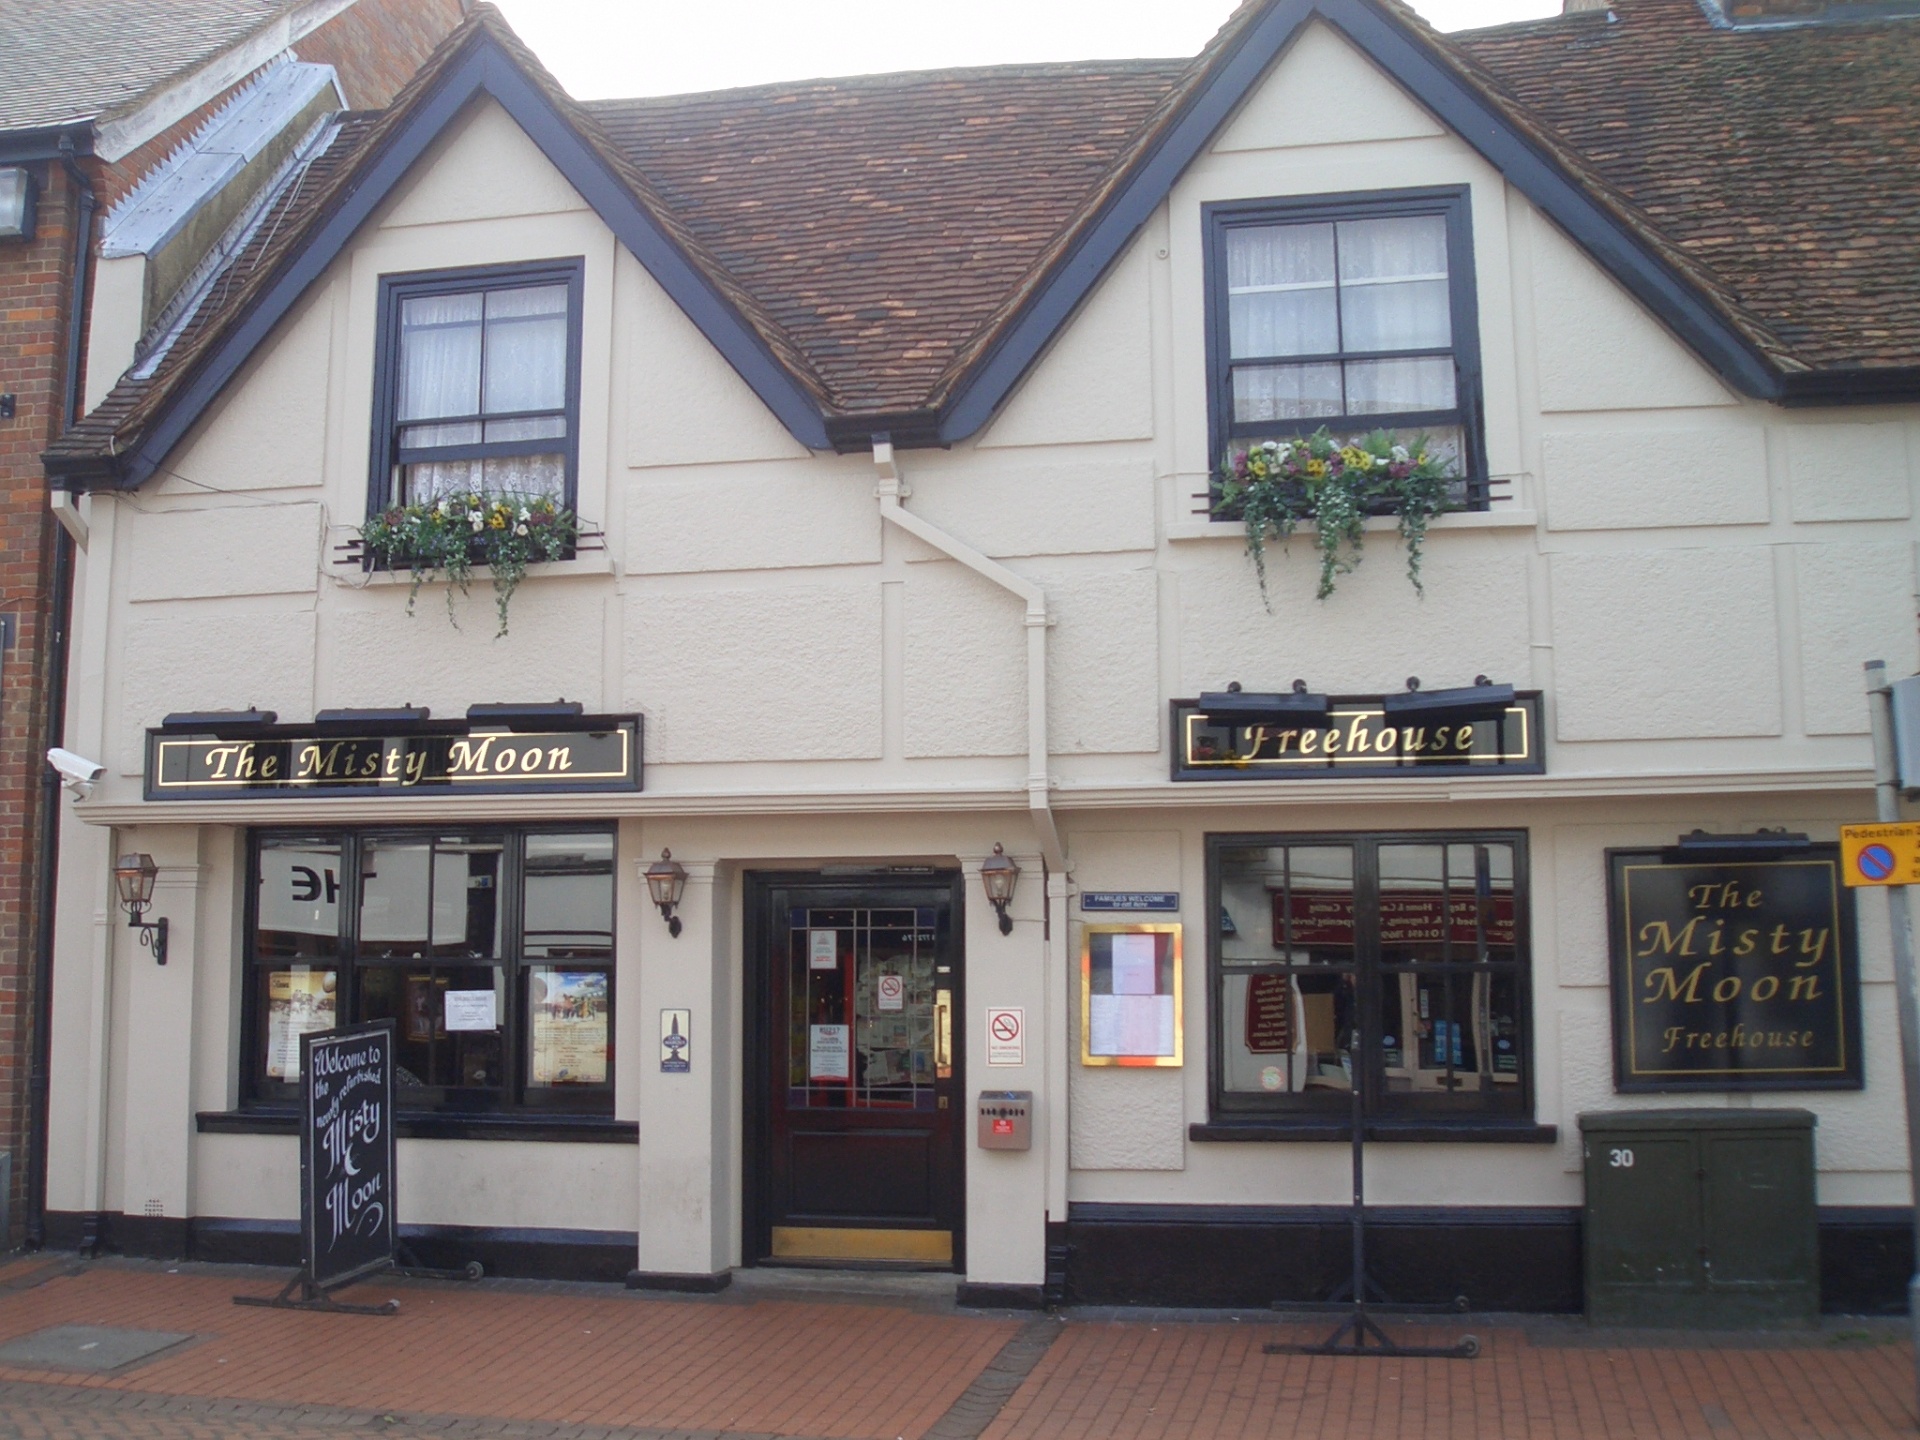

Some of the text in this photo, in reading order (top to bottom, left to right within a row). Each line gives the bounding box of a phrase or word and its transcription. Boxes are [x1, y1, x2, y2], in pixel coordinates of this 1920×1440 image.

[1241, 713, 1475, 761] Freehouse
[205, 736, 573, 788] The Misty Moon
[1844, 827, 1913, 840] Pedestrian
[1094, 895, 1166, 903] FAMILIES WELCOME
[1688, 880, 1764, 909] The
[1638, 916, 1830, 967] Misty
[1642, 961, 1823, 1004] Moon
[1661, 1023, 1815, 1053] Freehouse
[314, 1045, 380, 1076] Welcome to
[314, 1079, 329, 1099] the
[339, 1067, 381, 1100] refurbished
[322, 1100, 381, 1179] Misty
[1609, 1148, 1635, 1168] 30
[325, 1172, 382, 1253] Moon
